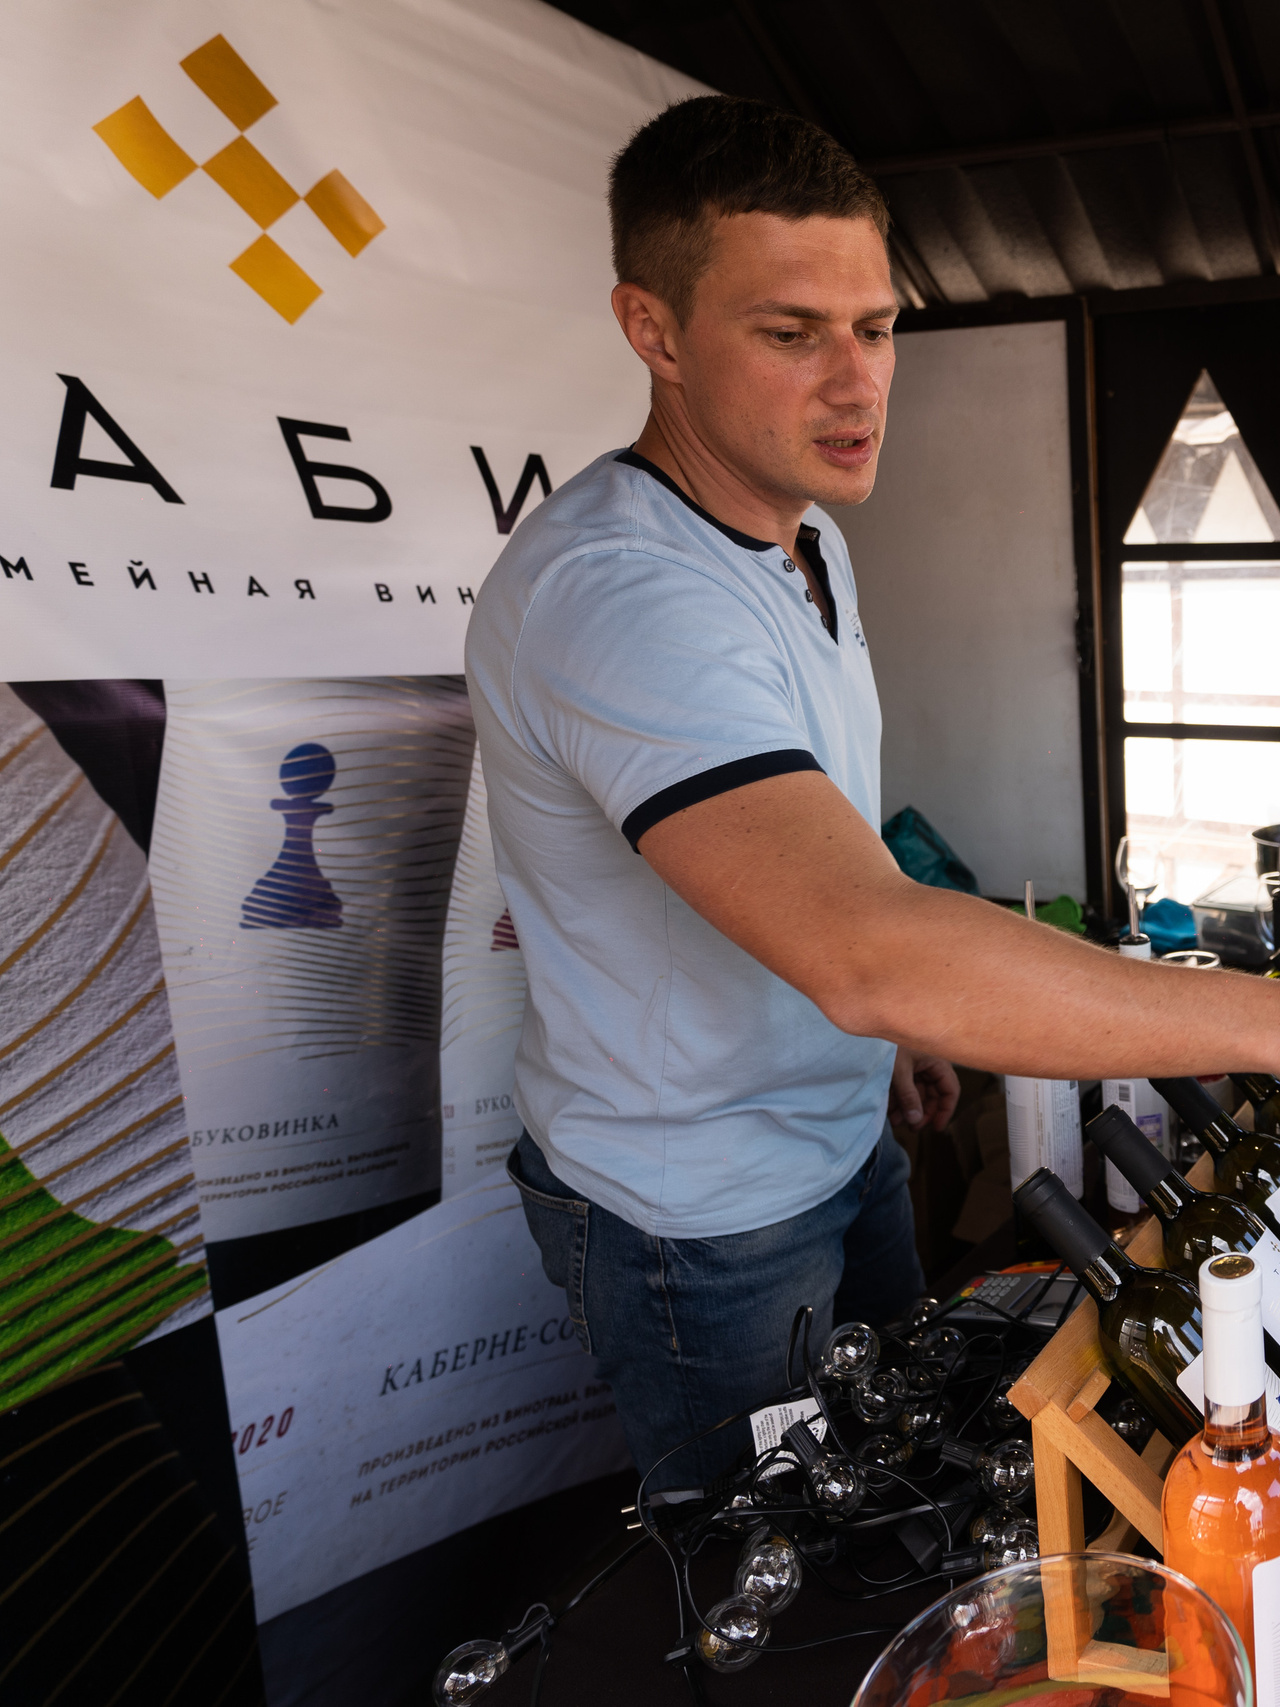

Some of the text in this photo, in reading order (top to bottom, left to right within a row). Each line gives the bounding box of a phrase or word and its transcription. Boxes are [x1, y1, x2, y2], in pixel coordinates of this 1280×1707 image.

[475, 1094, 515, 1115] БУКО
[191, 1113, 339, 1147] БУКОВИНКА
[358, 1422, 477, 1478] ПРОИЗВЕДЕНО
[481, 1413, 501, 1432] ИЗ
[350, 1491, 373, 1509] НА
[379, 1447, 480, 1496] ТЕРРИТОРИИ
